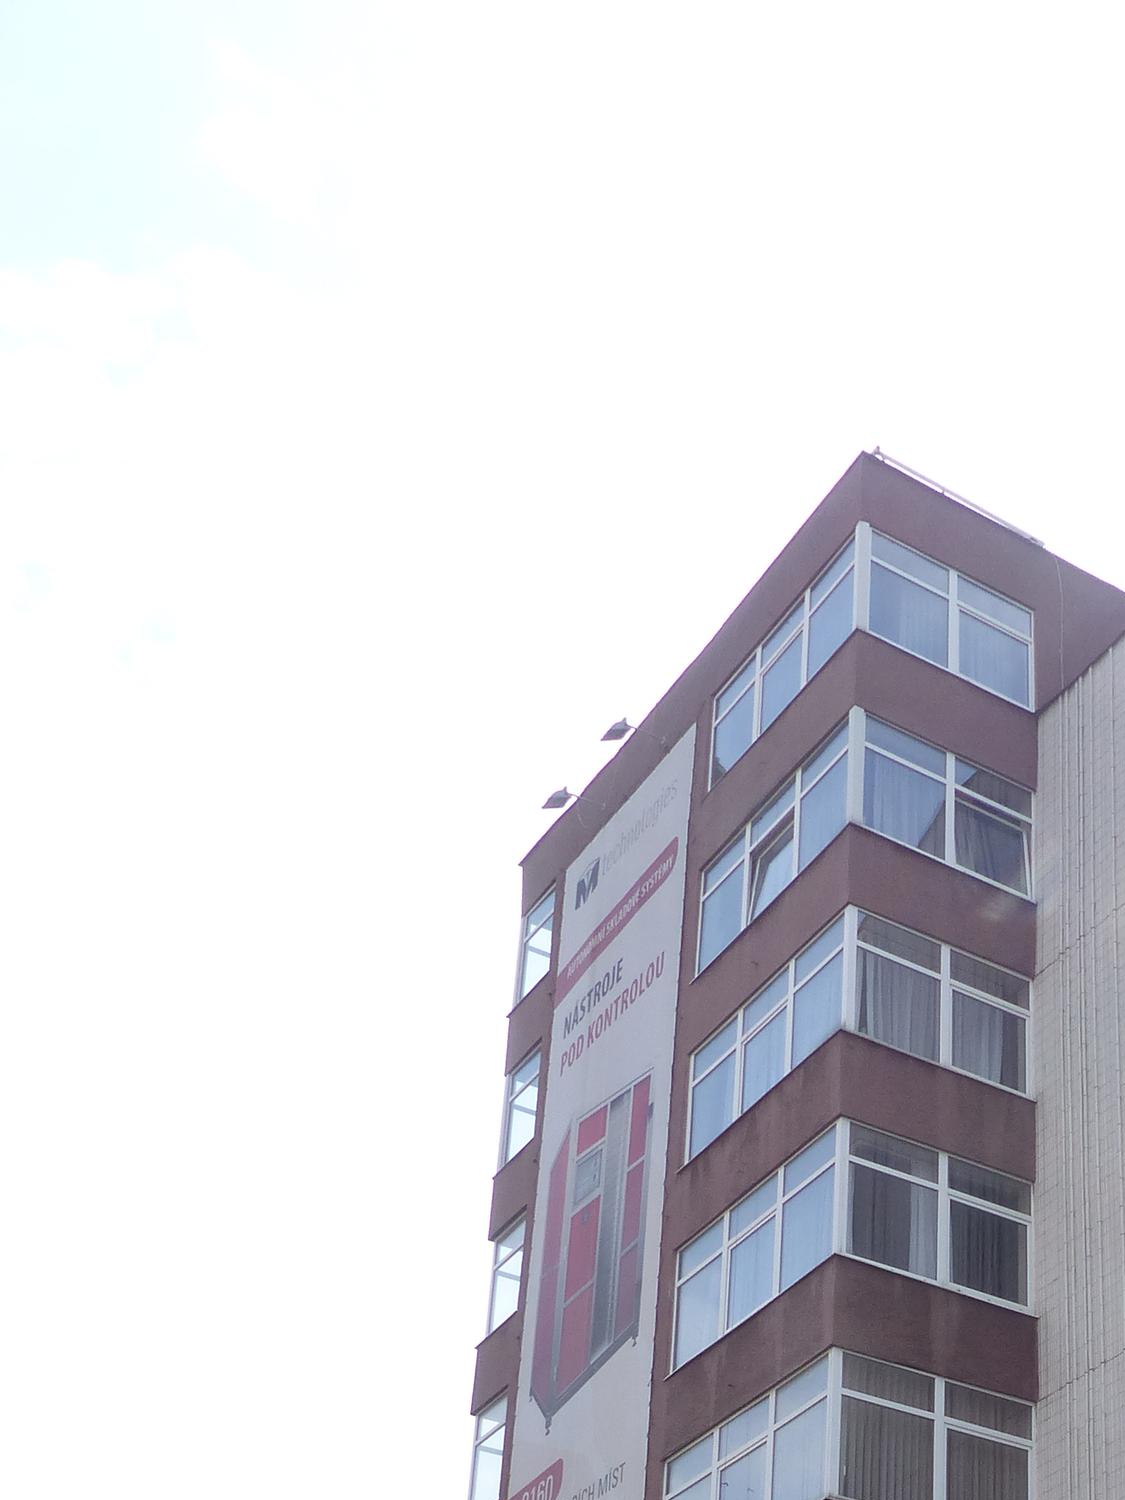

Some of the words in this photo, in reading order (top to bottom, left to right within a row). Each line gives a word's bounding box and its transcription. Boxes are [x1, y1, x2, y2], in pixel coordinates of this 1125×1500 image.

[560, 1034, 585, 1077] POD
[587, 951, 665, 1048] KONTROLOU
[597, 1461, 627, 1498] MÍST
